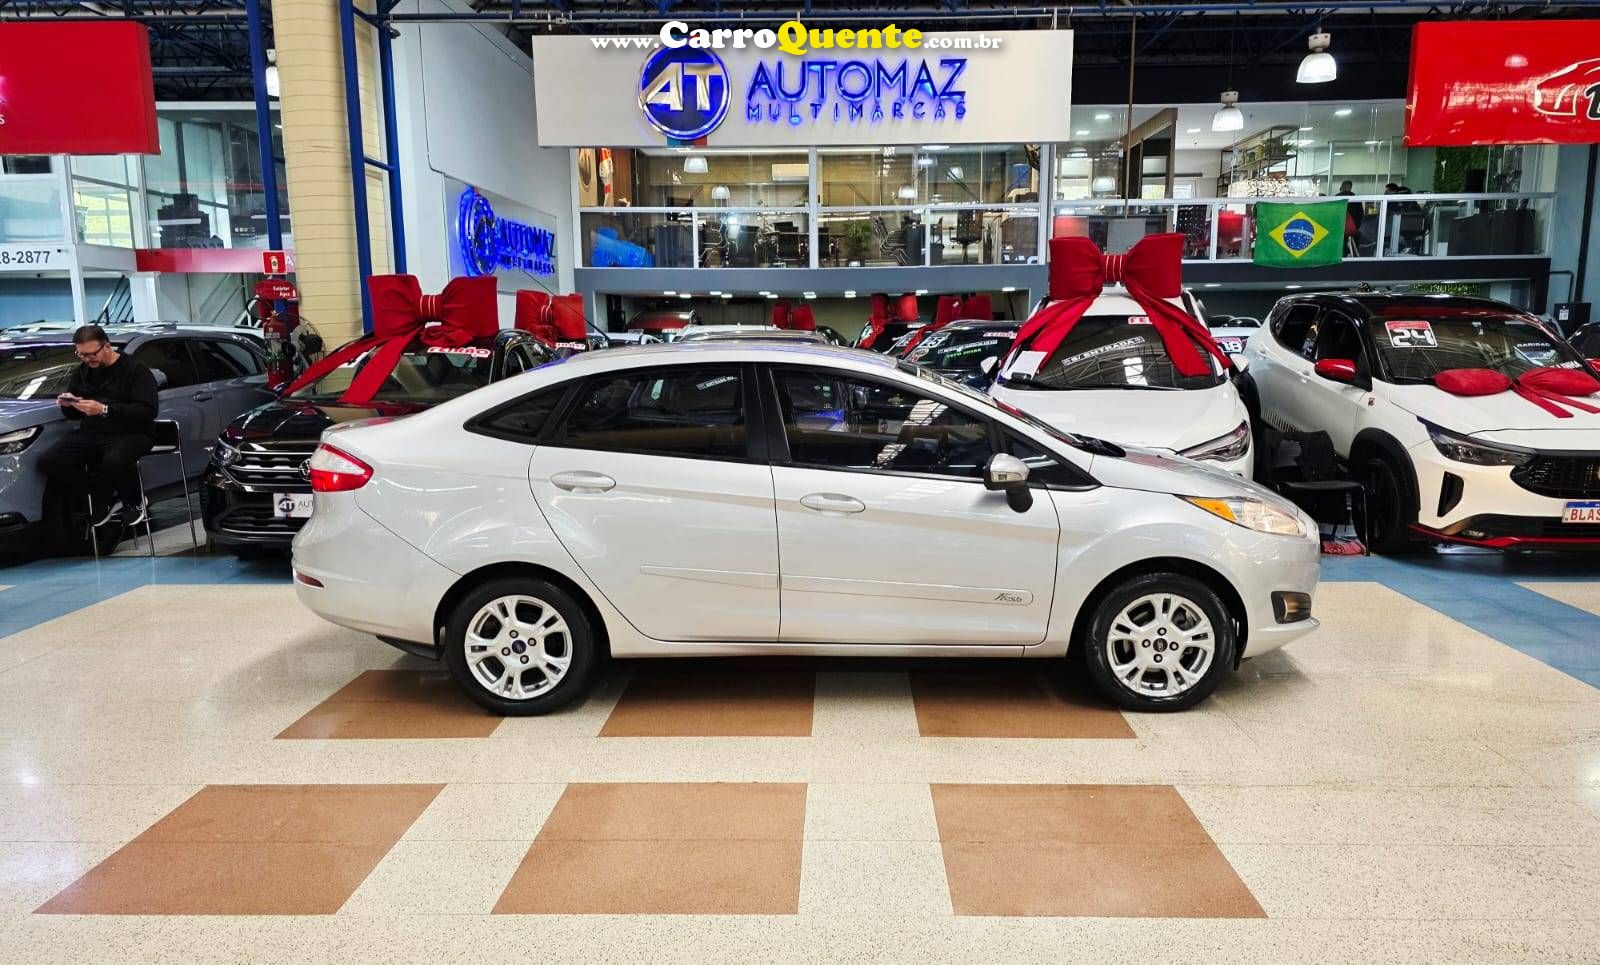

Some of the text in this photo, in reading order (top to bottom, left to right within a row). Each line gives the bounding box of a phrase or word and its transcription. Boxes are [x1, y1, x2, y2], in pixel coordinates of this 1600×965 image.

[640, 61, 725, 113] AT
[747, 58, 968, 101] AUTOMAZ
[747, 101, 967, 120] MULTIMARCAS
[0, 250, 51, 264] 8-2877
[1393, 328, 1435, 346] 24
